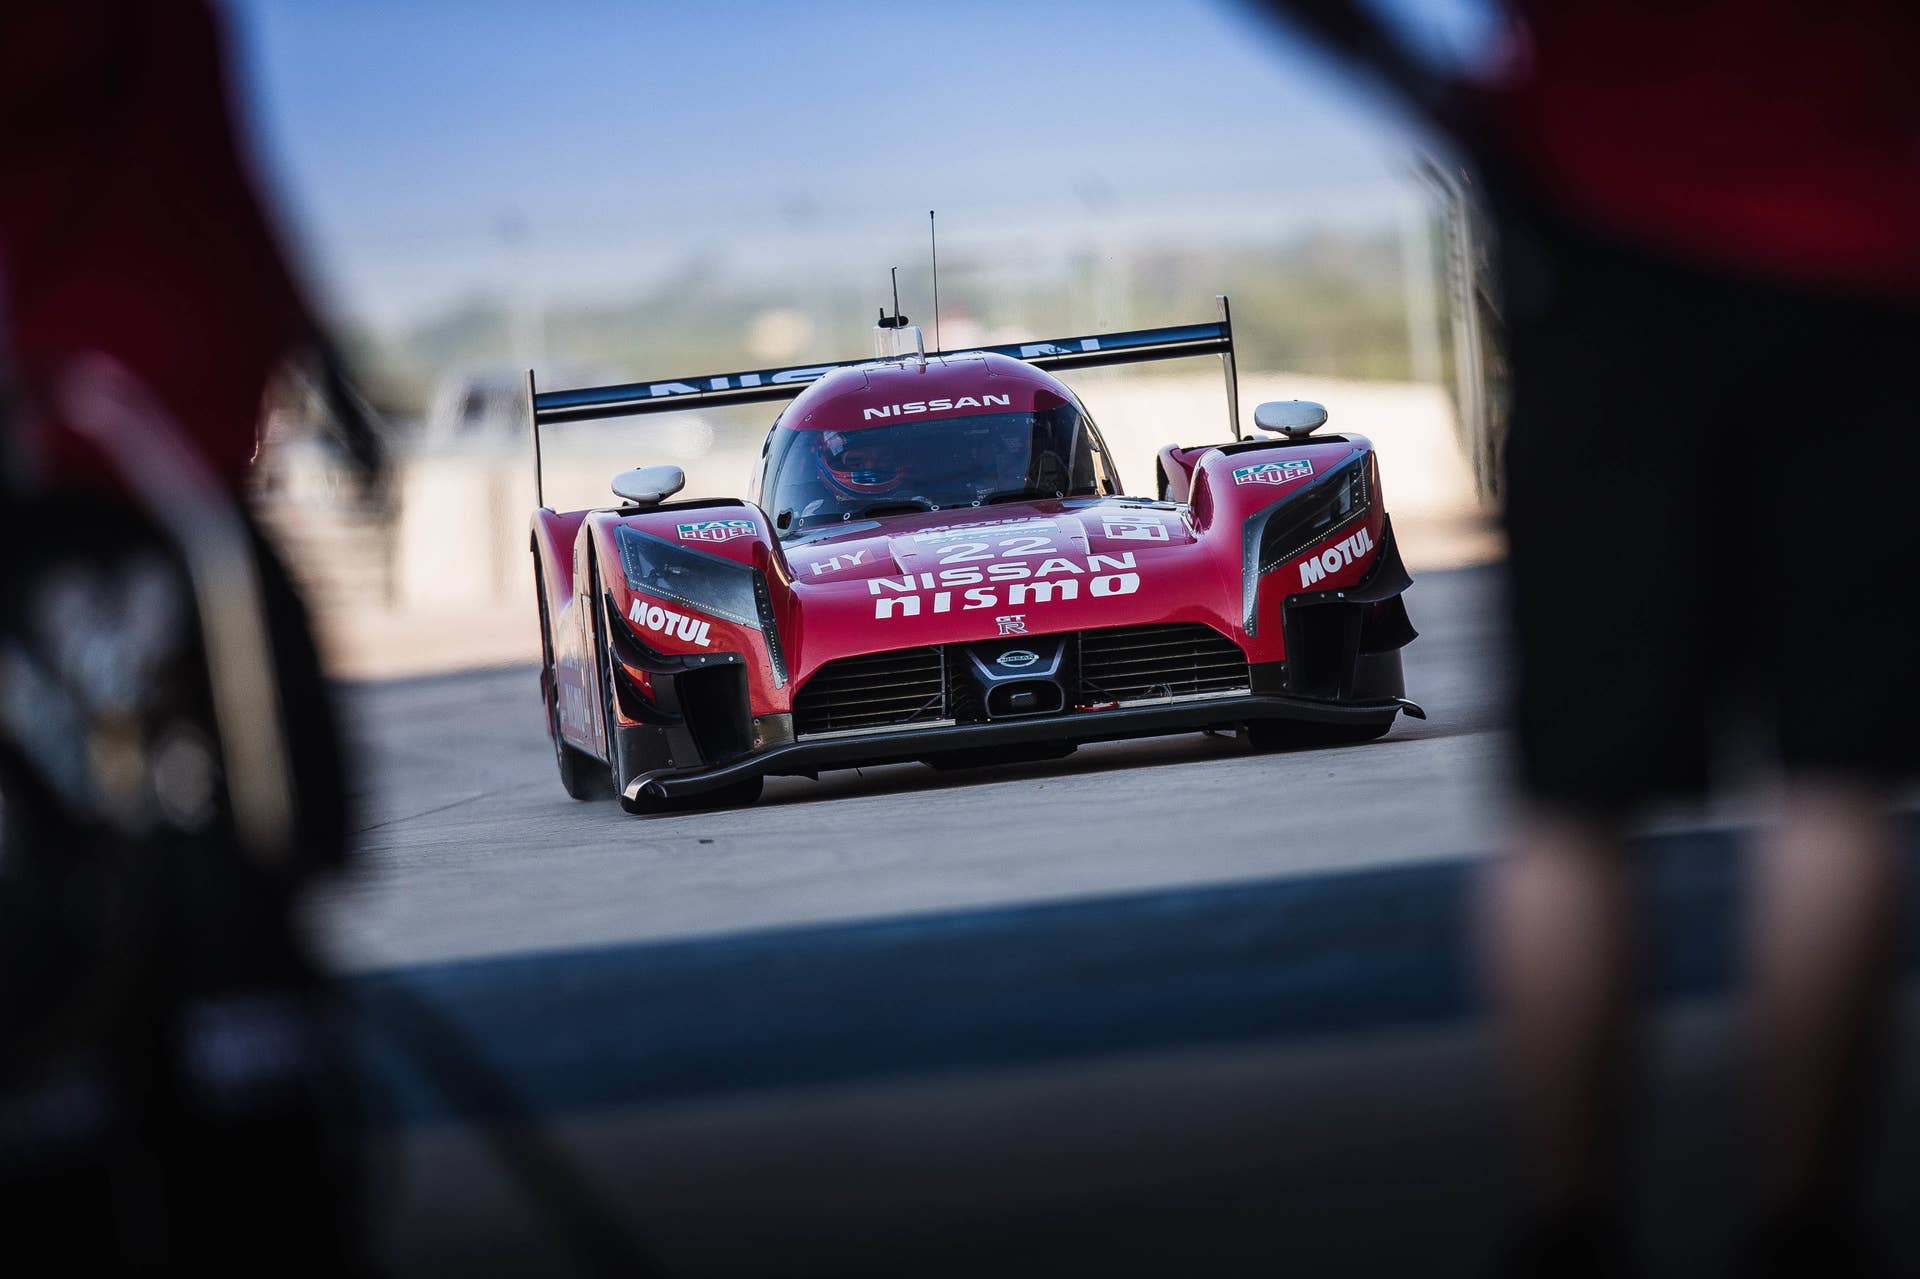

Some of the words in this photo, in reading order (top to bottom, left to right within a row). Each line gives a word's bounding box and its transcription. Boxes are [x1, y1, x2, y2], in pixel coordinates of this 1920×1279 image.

[863, 394, 1010, 420] NISSAN
[1237, 467, 1313, 484] HEUER
[1245, 460, 1306, 475] TAG
[682, 528, 756, 541] HEUER
[684, 520, 754, 533] TAG
[1109, 524, 1161, 538] P1
[808, 549, 868, 576] HY
[936, 536, 1058, 565] 22
[1299, 527, 1373, 589] MOTUL
[867, 552, 1137, 596] NISSAN
[875, 571, 1141, 620] nismo
[628, 598, 711, 648] MOTUL
